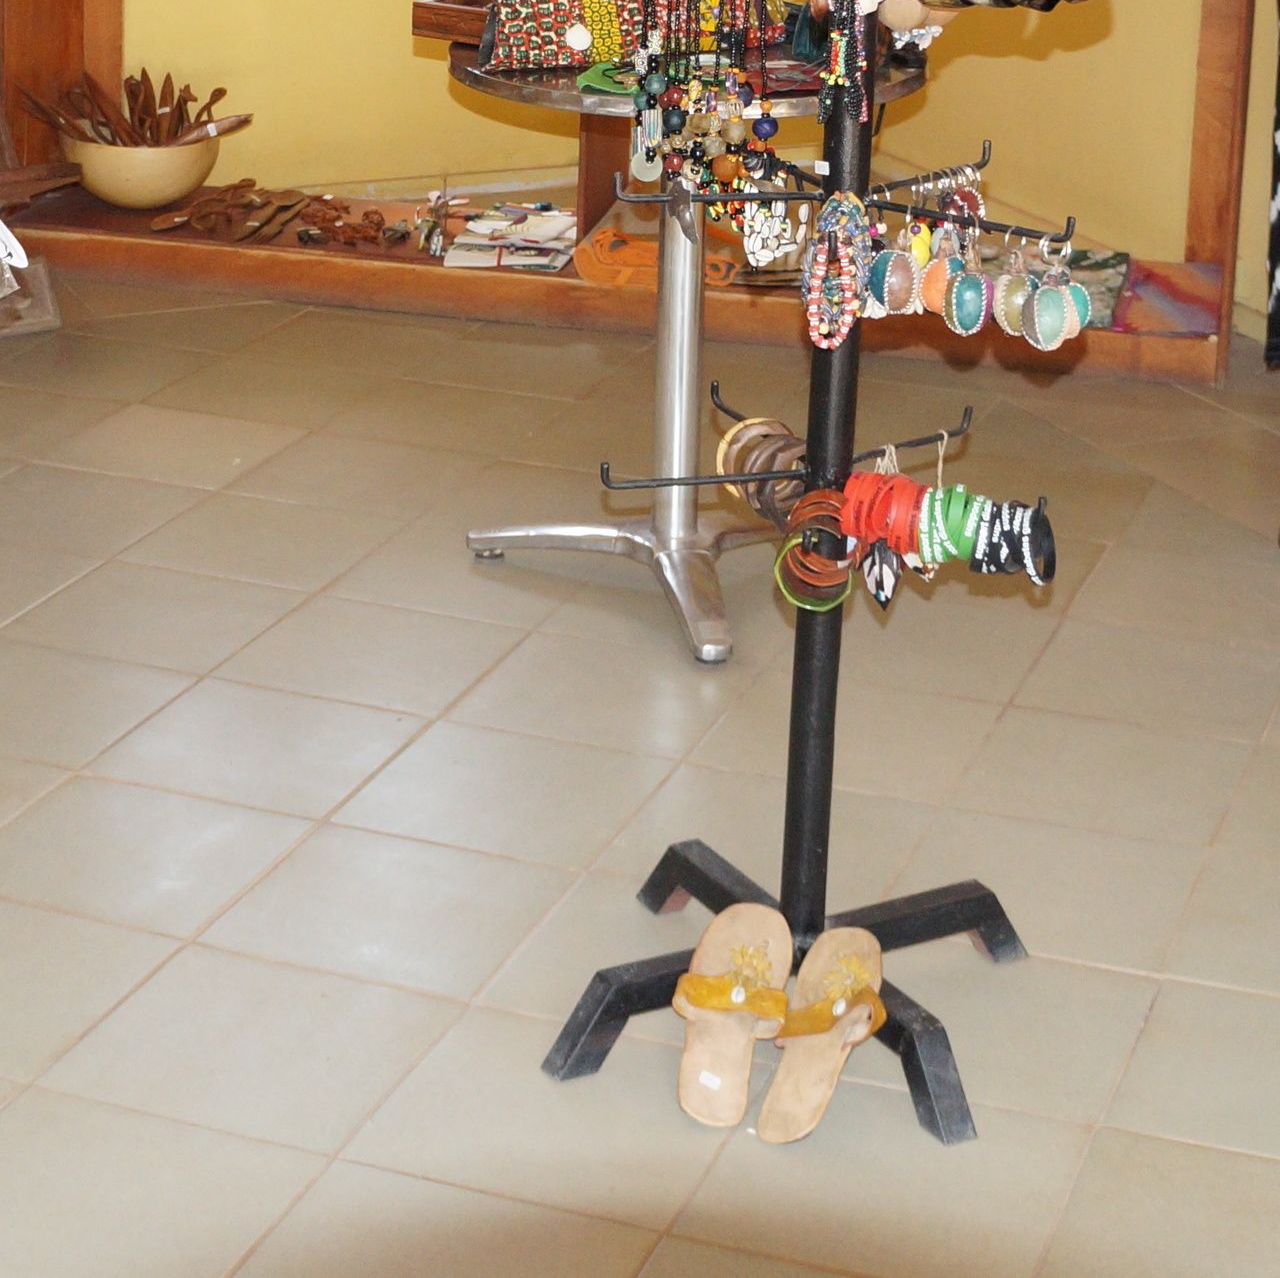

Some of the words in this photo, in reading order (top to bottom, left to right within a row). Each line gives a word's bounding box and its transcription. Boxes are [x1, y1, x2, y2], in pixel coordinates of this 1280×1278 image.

[964, 501, 982, 537] support
[975, 521, 989, 559] support
[1021, 536, 1037, 576] diabetes
